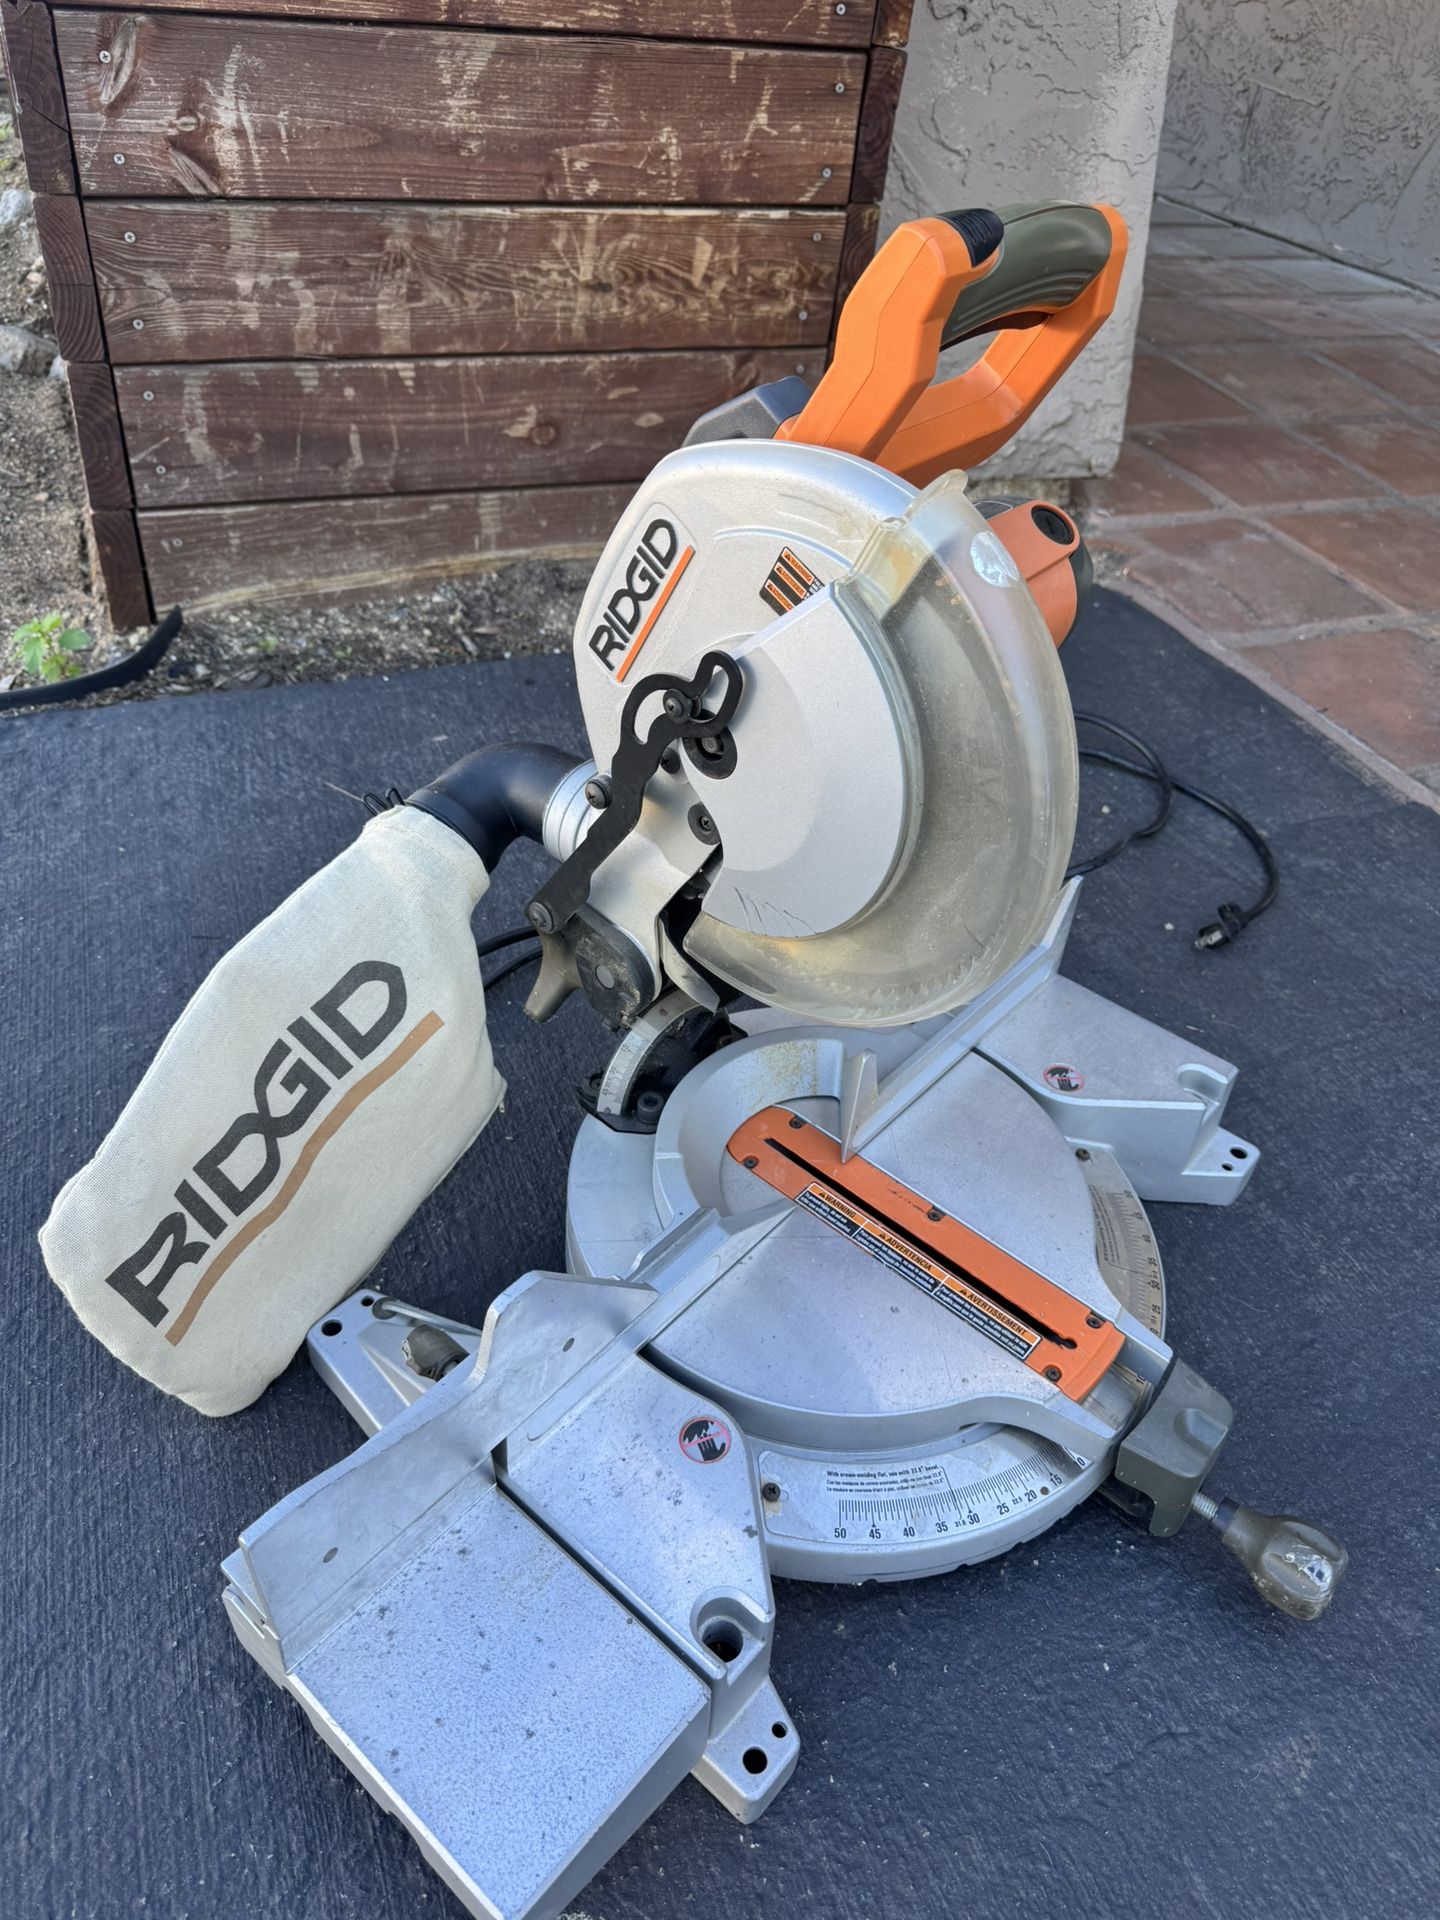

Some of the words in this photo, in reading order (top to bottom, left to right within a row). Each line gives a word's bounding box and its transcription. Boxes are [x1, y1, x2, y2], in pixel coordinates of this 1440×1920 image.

[589, 519, 677, 670] RIDGID
[106, 960, 407, 1327] RIDGID
[824, 1194, 856, 1218] WARNING
[885, 1236, 933, 1271] ADVERTENCIA
[966, 1292, 1027, 1335] AVERTISSEMENT
[1152, 1304, 1160, 1314] 25
[1050, 1474, 1062, 1486] 15
[1024, 1490, 1037, 1502] 20
[997, 1503, 1009, 1515] 25
[967, 1513, 980, 1525] 30
[834, 1528, 847, 1538] 50
[903, 1526, 915, 1537] 40
[936, 1522, 948, 1533] 35
[869, 1529, 881, 1539] 45
